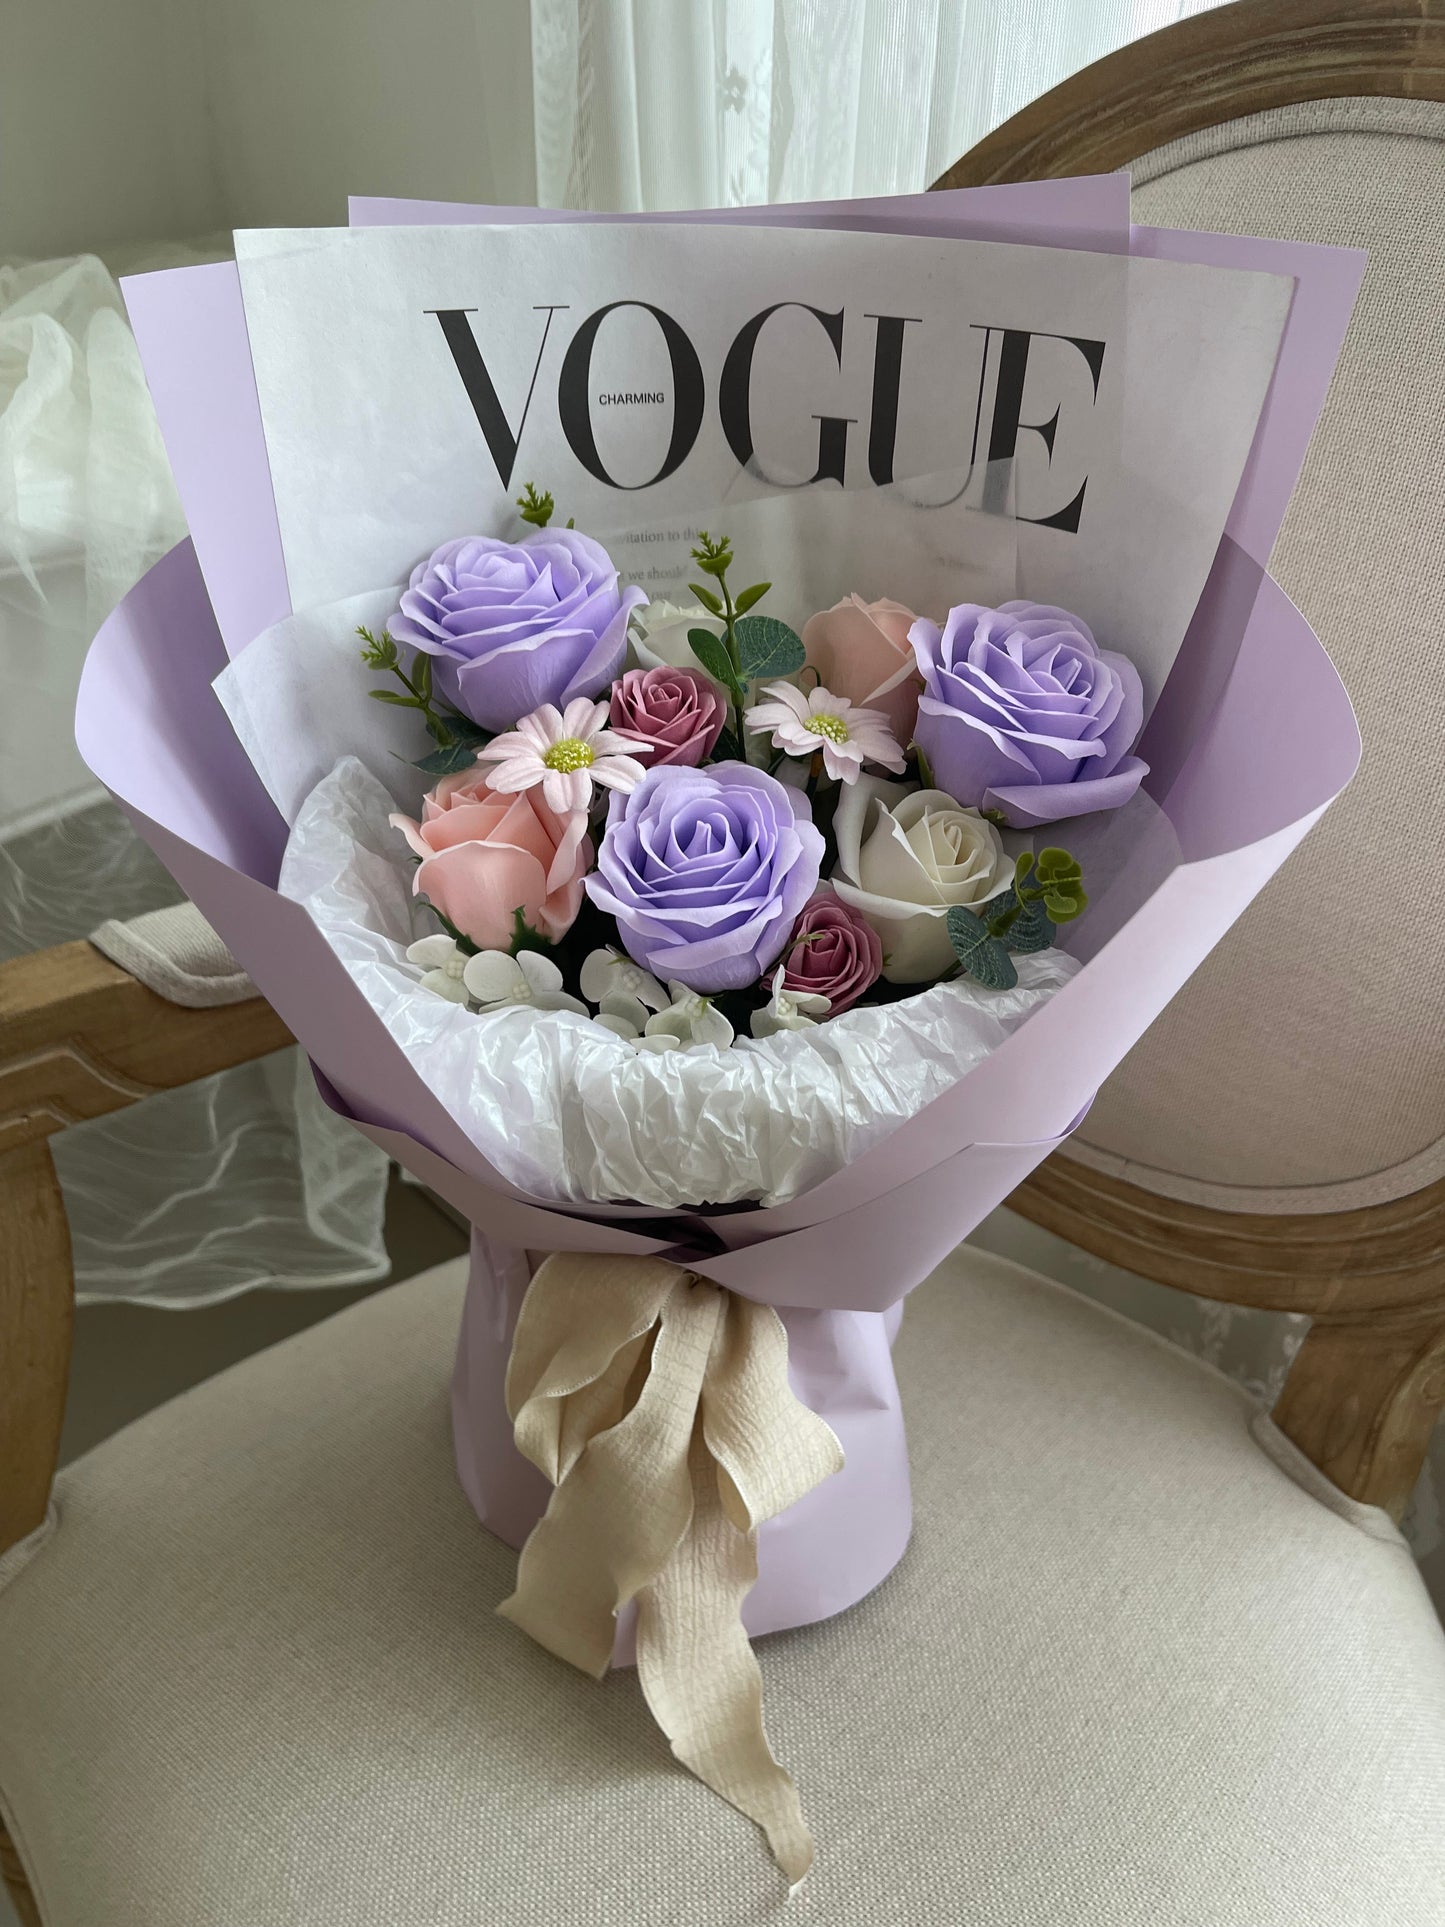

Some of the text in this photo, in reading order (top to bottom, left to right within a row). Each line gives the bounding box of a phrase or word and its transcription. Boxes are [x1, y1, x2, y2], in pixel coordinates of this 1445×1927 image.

[598, 392, 665, 406] CHARMING
[423, 301, 1106, 533] VOGUE
[667, 530, 681, 542] to
[628, 565, 686, 581] we shoul
